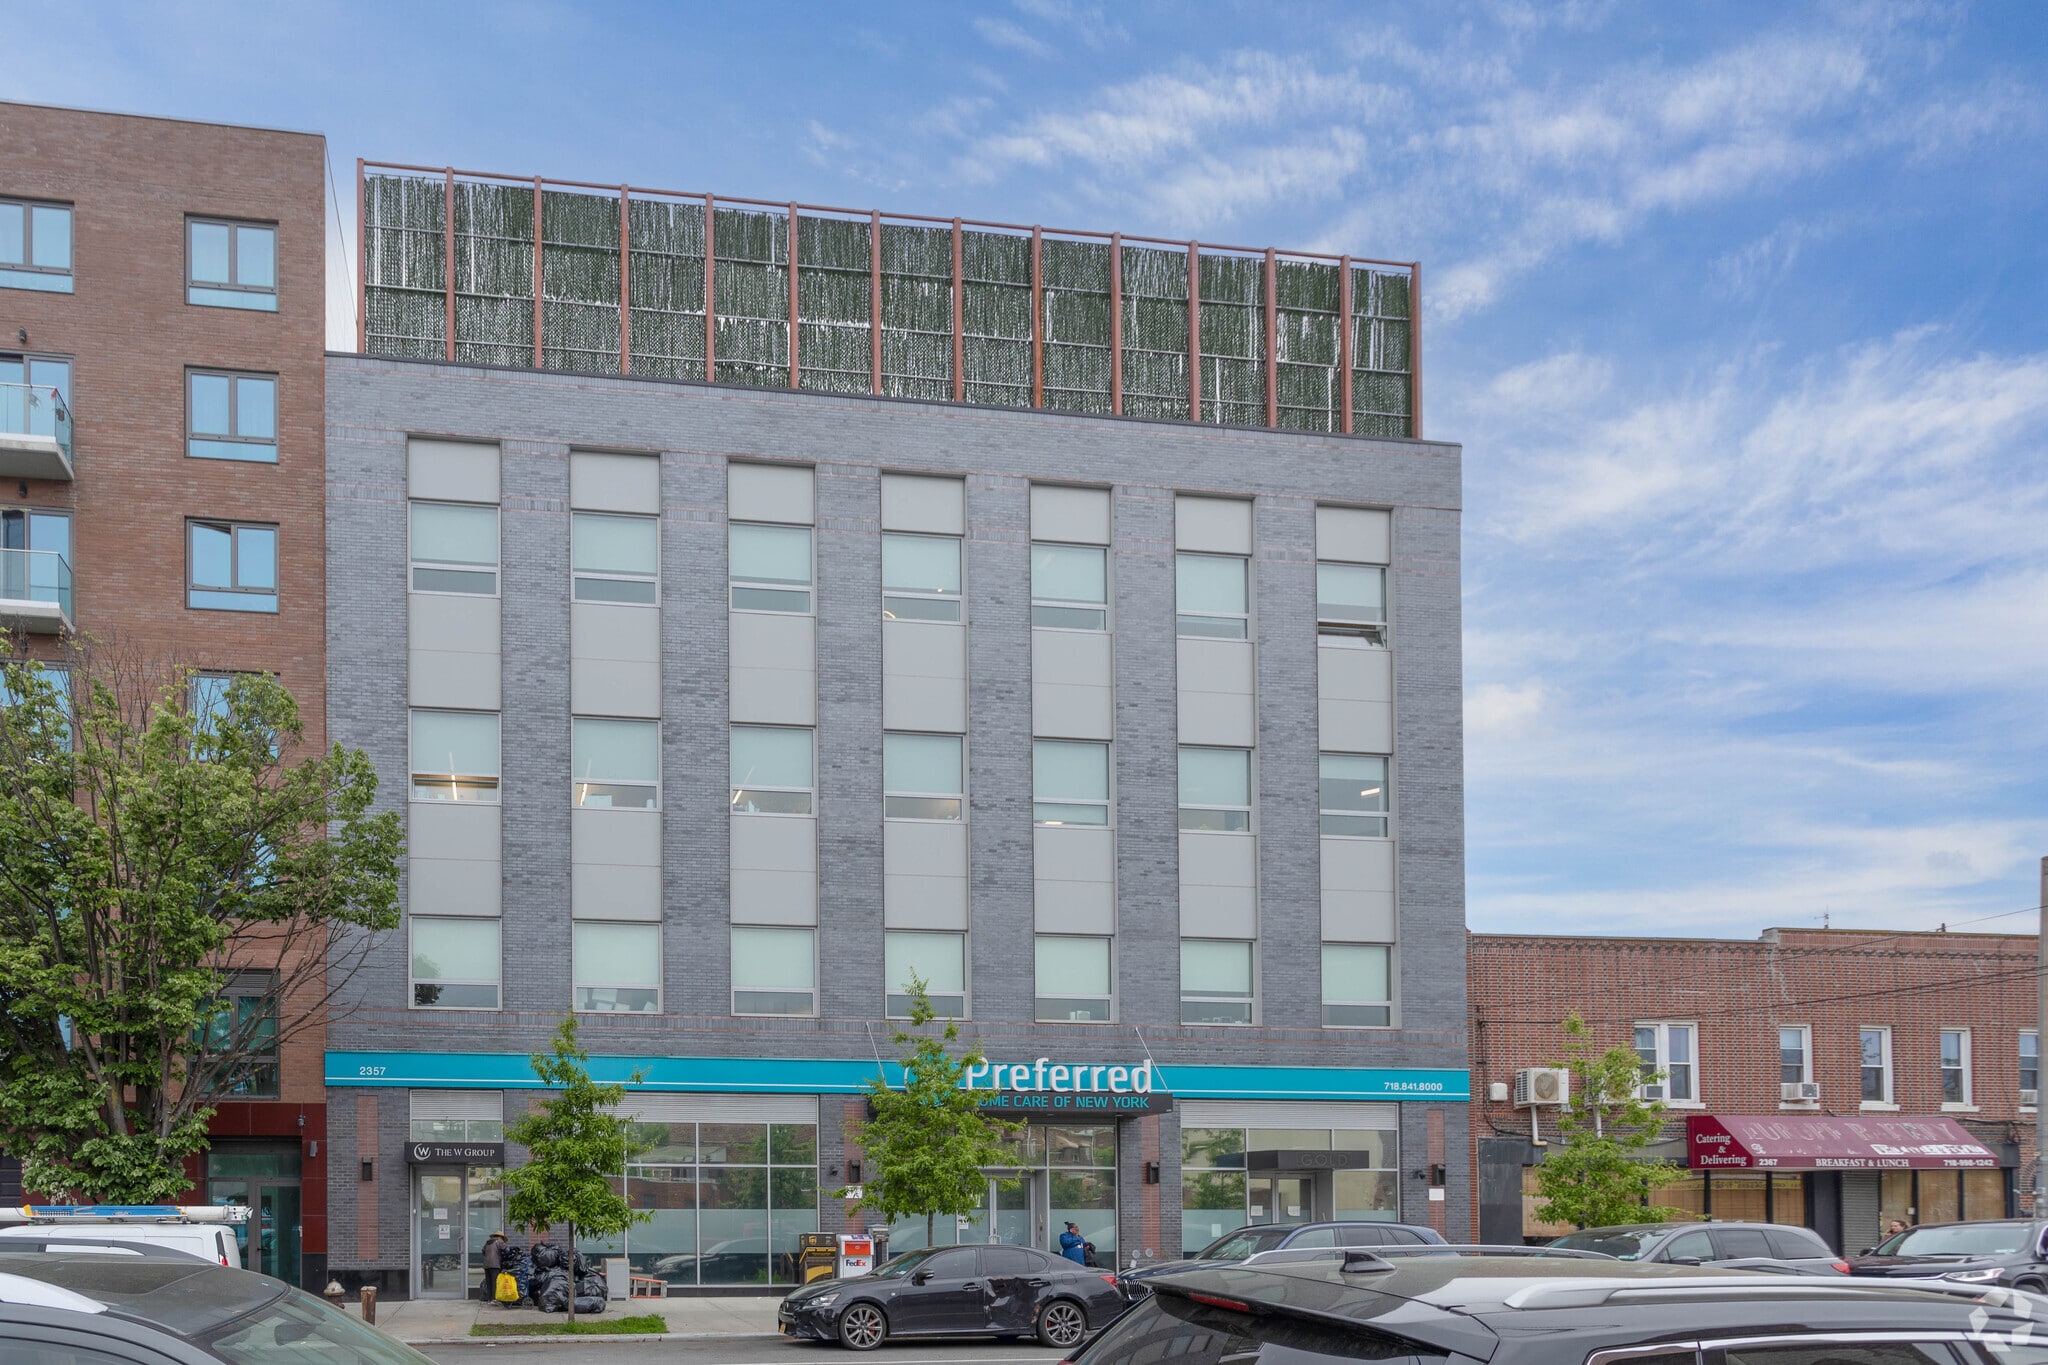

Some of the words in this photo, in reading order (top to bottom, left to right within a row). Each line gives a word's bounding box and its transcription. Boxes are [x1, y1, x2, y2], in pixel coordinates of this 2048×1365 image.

[359, 1066, 386, 1076] 2357
[966, 1056, 1152, 1094] Preferred
[1384, 1082, 1443, 1091] 718.841.8000
[978, 1095, 1009, 1108] OME
[1013, 1096, 1048, 1108] CARE
[1054, 1096, 1071, 1108] OF
[1076, 1096, 1109, 1109] NEW
[1113, 1096, 1150, 1109] YORK
[1695, 1133, 1731, 1145] Catering
[434, 1148, 452, 1157] THE
[453, 1148, 462, 1157] W
[464, 1148, 495, 1157] GROUP
[1700, 1154, 1747, 1166] Delivering
[1815, 1158, 1866, 1167] BREAKFAST
[1868, 1159, 1874, 1167] &
[1876, 1159, 1910, 1167] LUNCH
